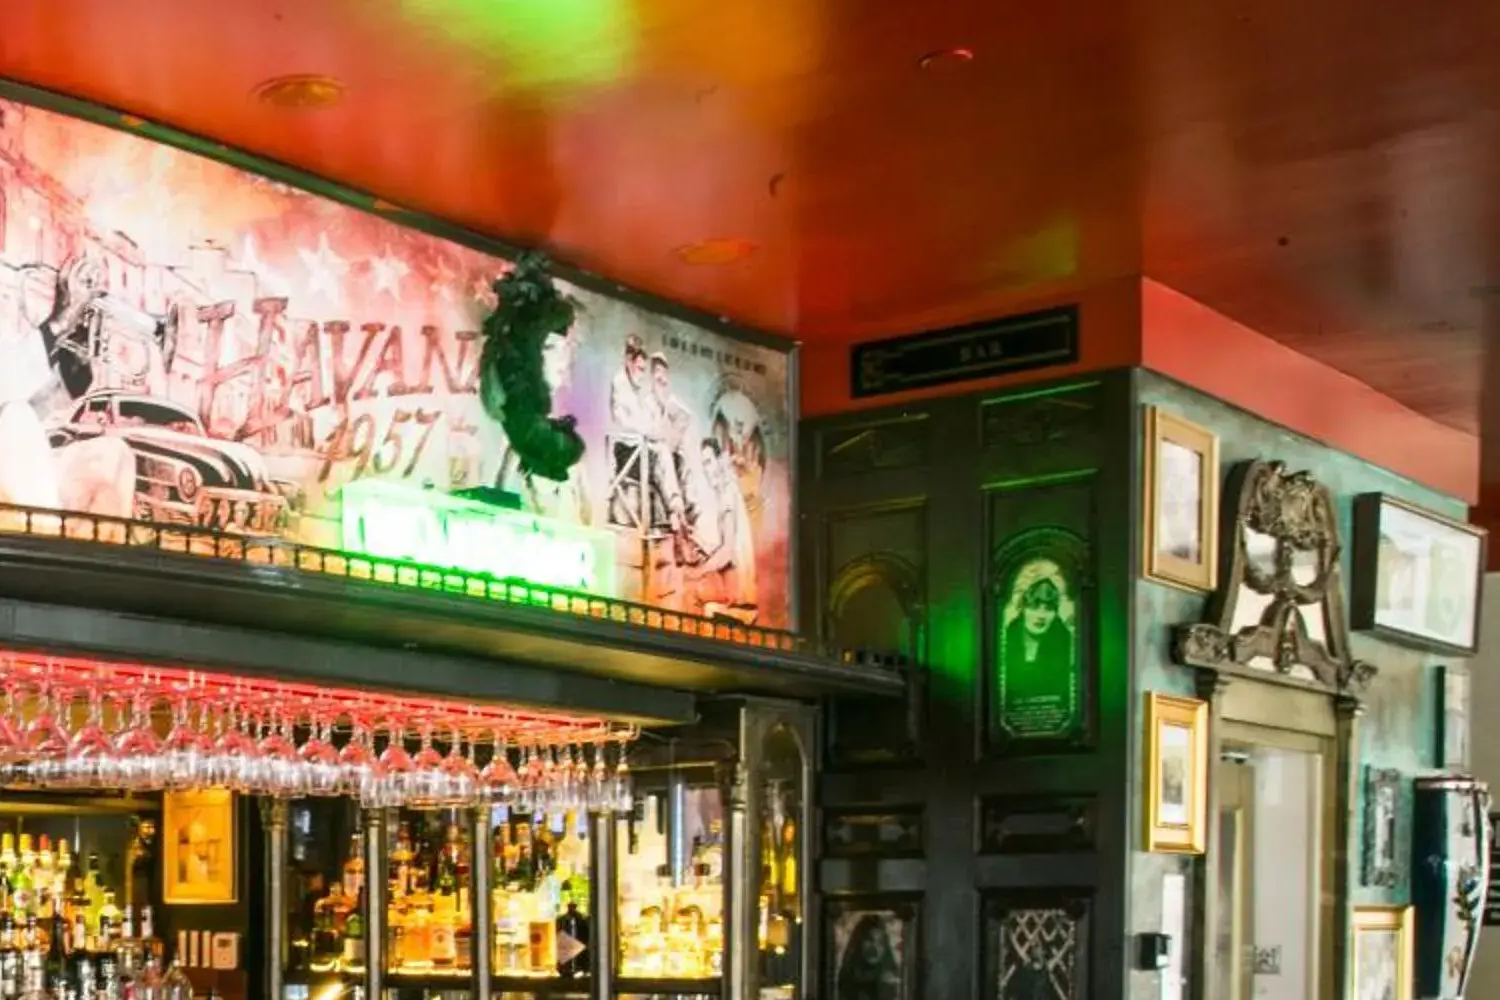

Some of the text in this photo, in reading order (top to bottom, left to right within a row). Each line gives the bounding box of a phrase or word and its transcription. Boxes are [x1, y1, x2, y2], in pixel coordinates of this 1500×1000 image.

[197, 297, 484, 440] HAVAN
[960, 341, 1004, 362] BAR
[317, 408, 440, 482] 1957
